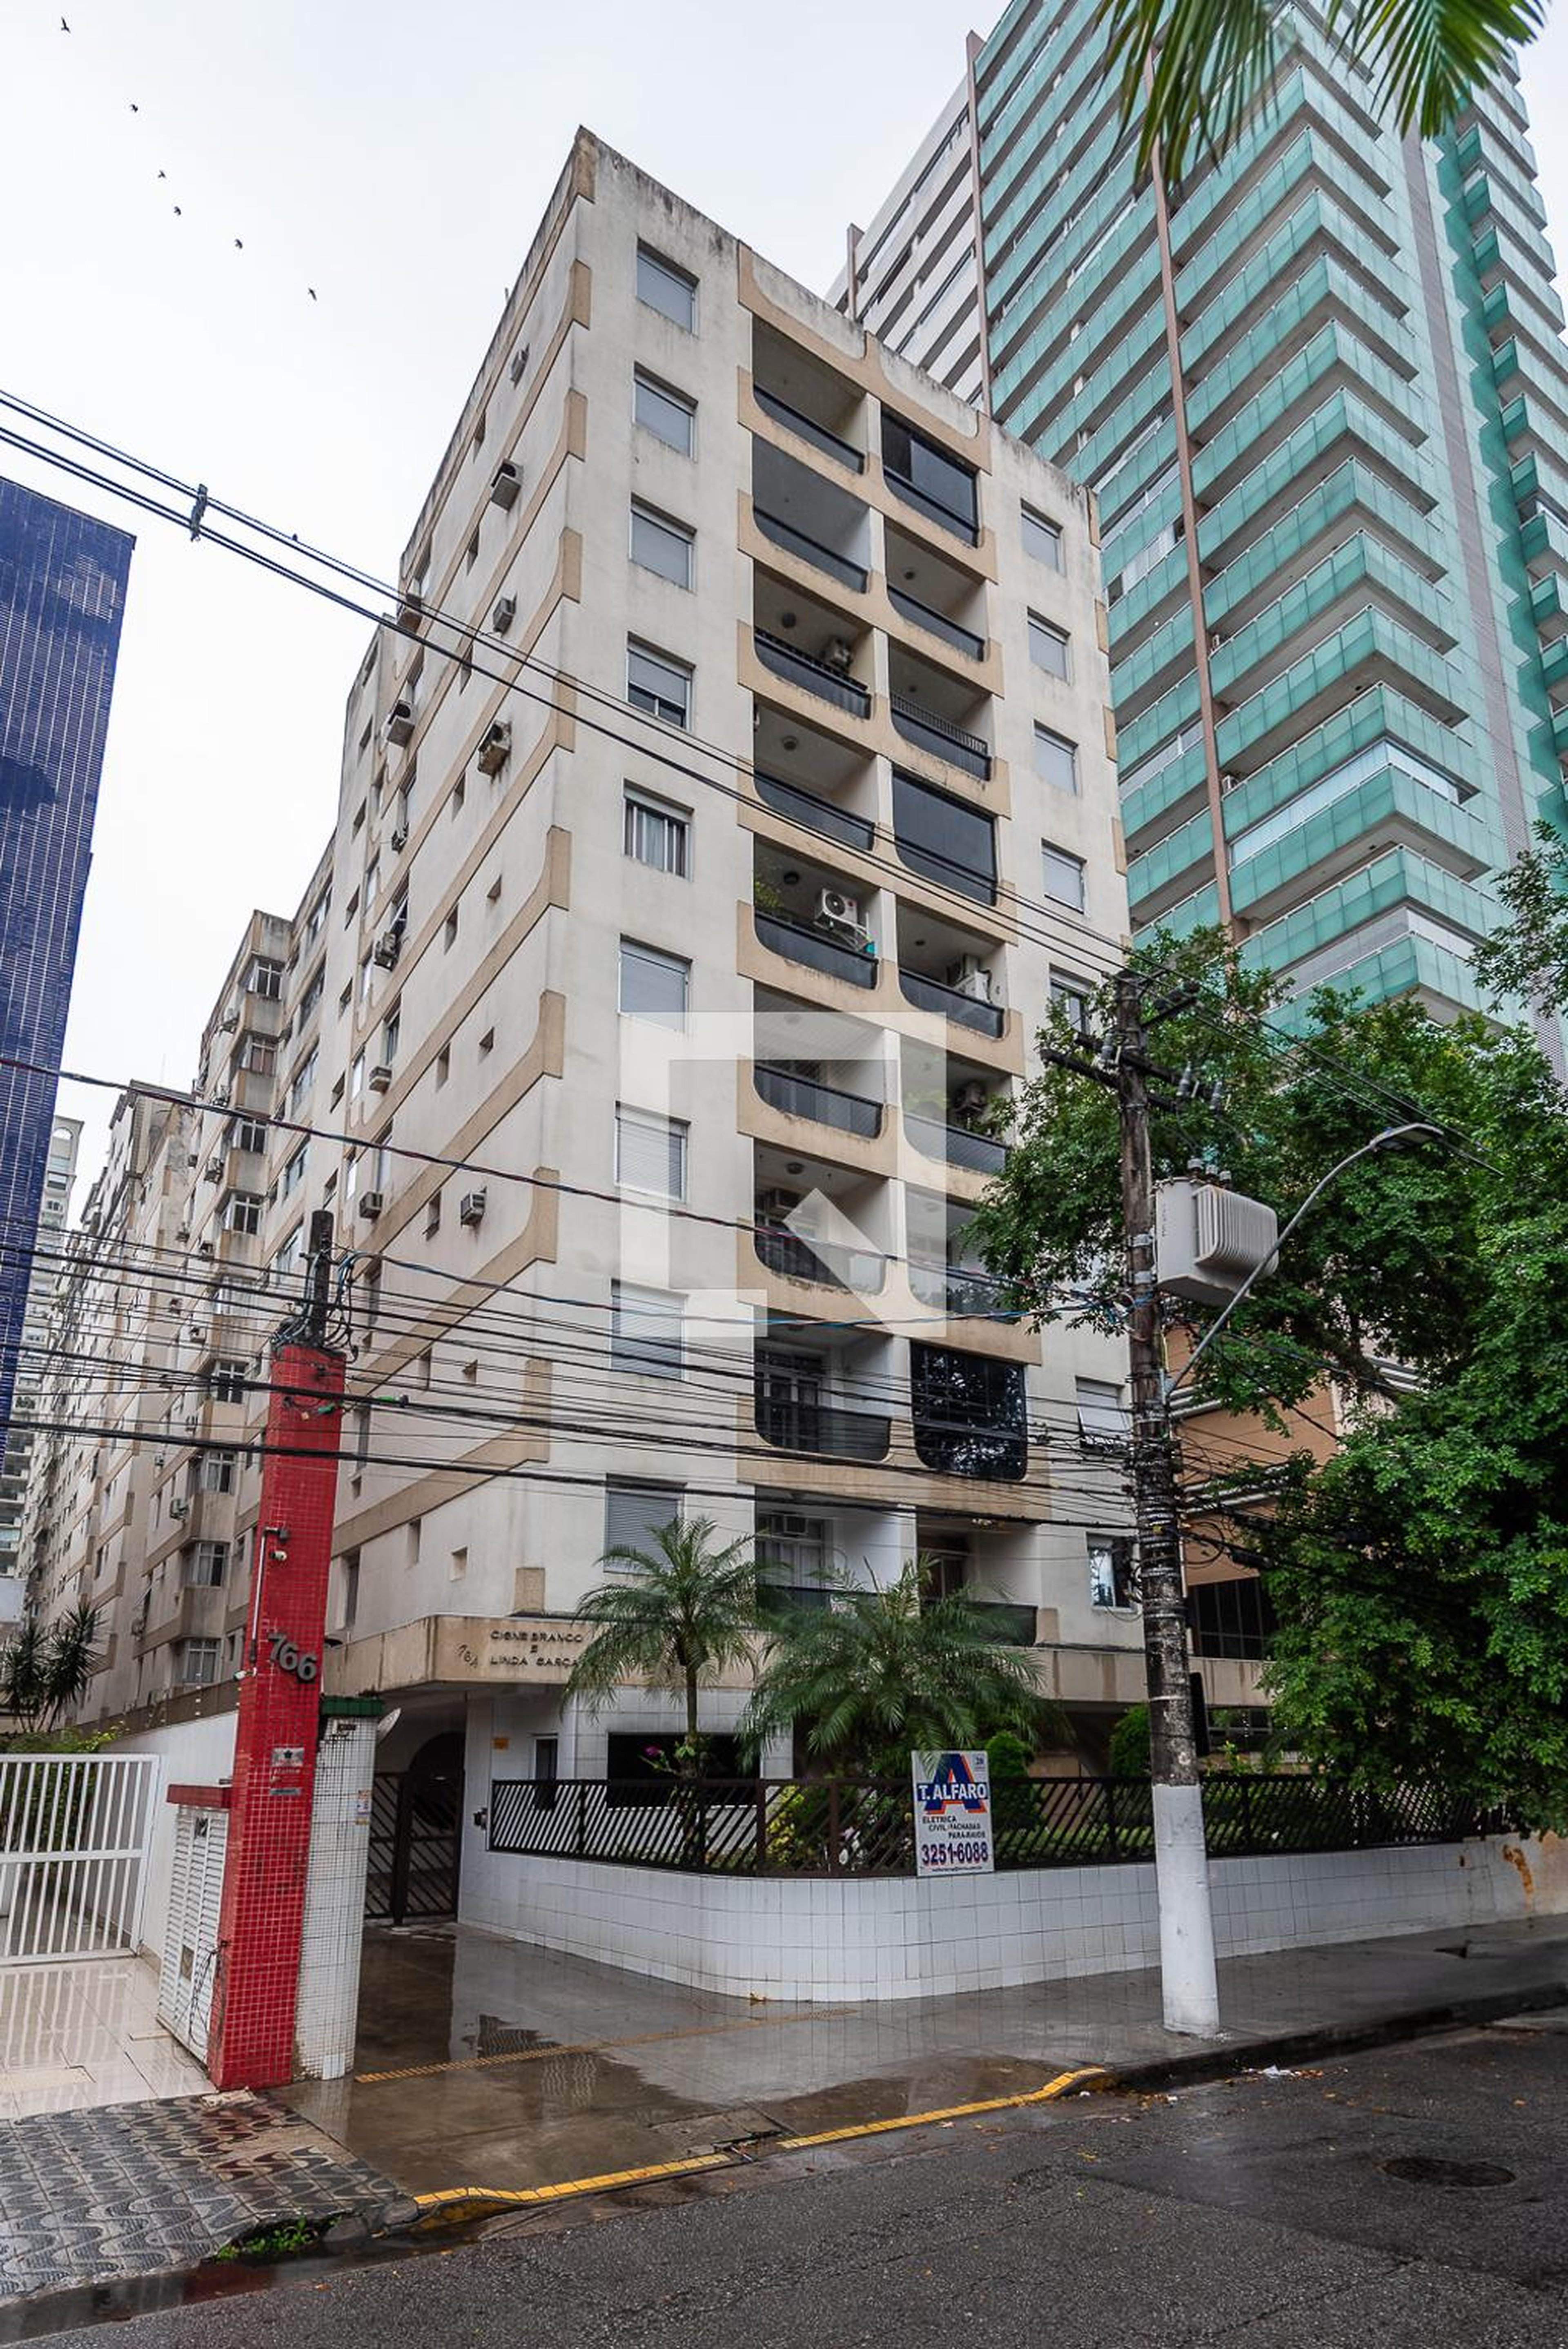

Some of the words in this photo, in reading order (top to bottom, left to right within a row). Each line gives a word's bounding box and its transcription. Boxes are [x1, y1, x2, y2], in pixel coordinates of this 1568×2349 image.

[530, 1632, 583, 1643] BRANCO
[268, 1632, 317, 1680] 766
[490, 1656, 528, 1665] LINDA
[933, 1783, 987, 1800] ALFARO
[921, 1841, 988, 1864] 3251-6088
